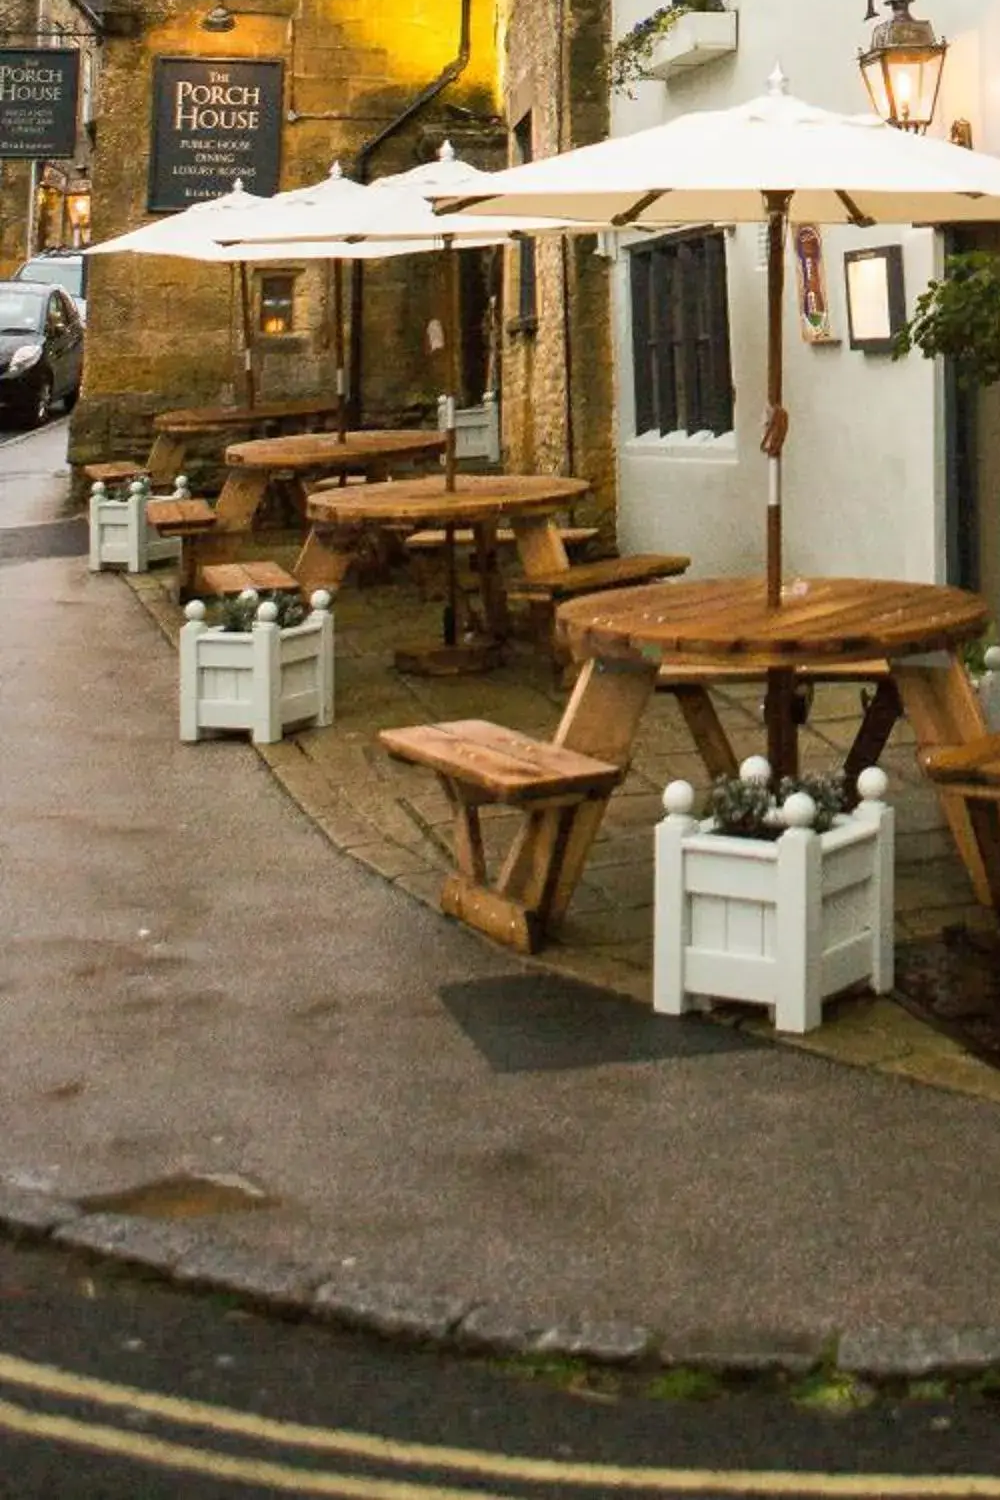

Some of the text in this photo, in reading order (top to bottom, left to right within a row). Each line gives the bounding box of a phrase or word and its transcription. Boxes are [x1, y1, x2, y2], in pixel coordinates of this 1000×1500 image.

[0, 65, 63, 83] PORCH
[0, 83, 62, 101] HOUSE
[176, 81, 261, 105] PORCH
[175, 105, 259, 130] HOUSE
[194, 153, 235, 163] DINING
